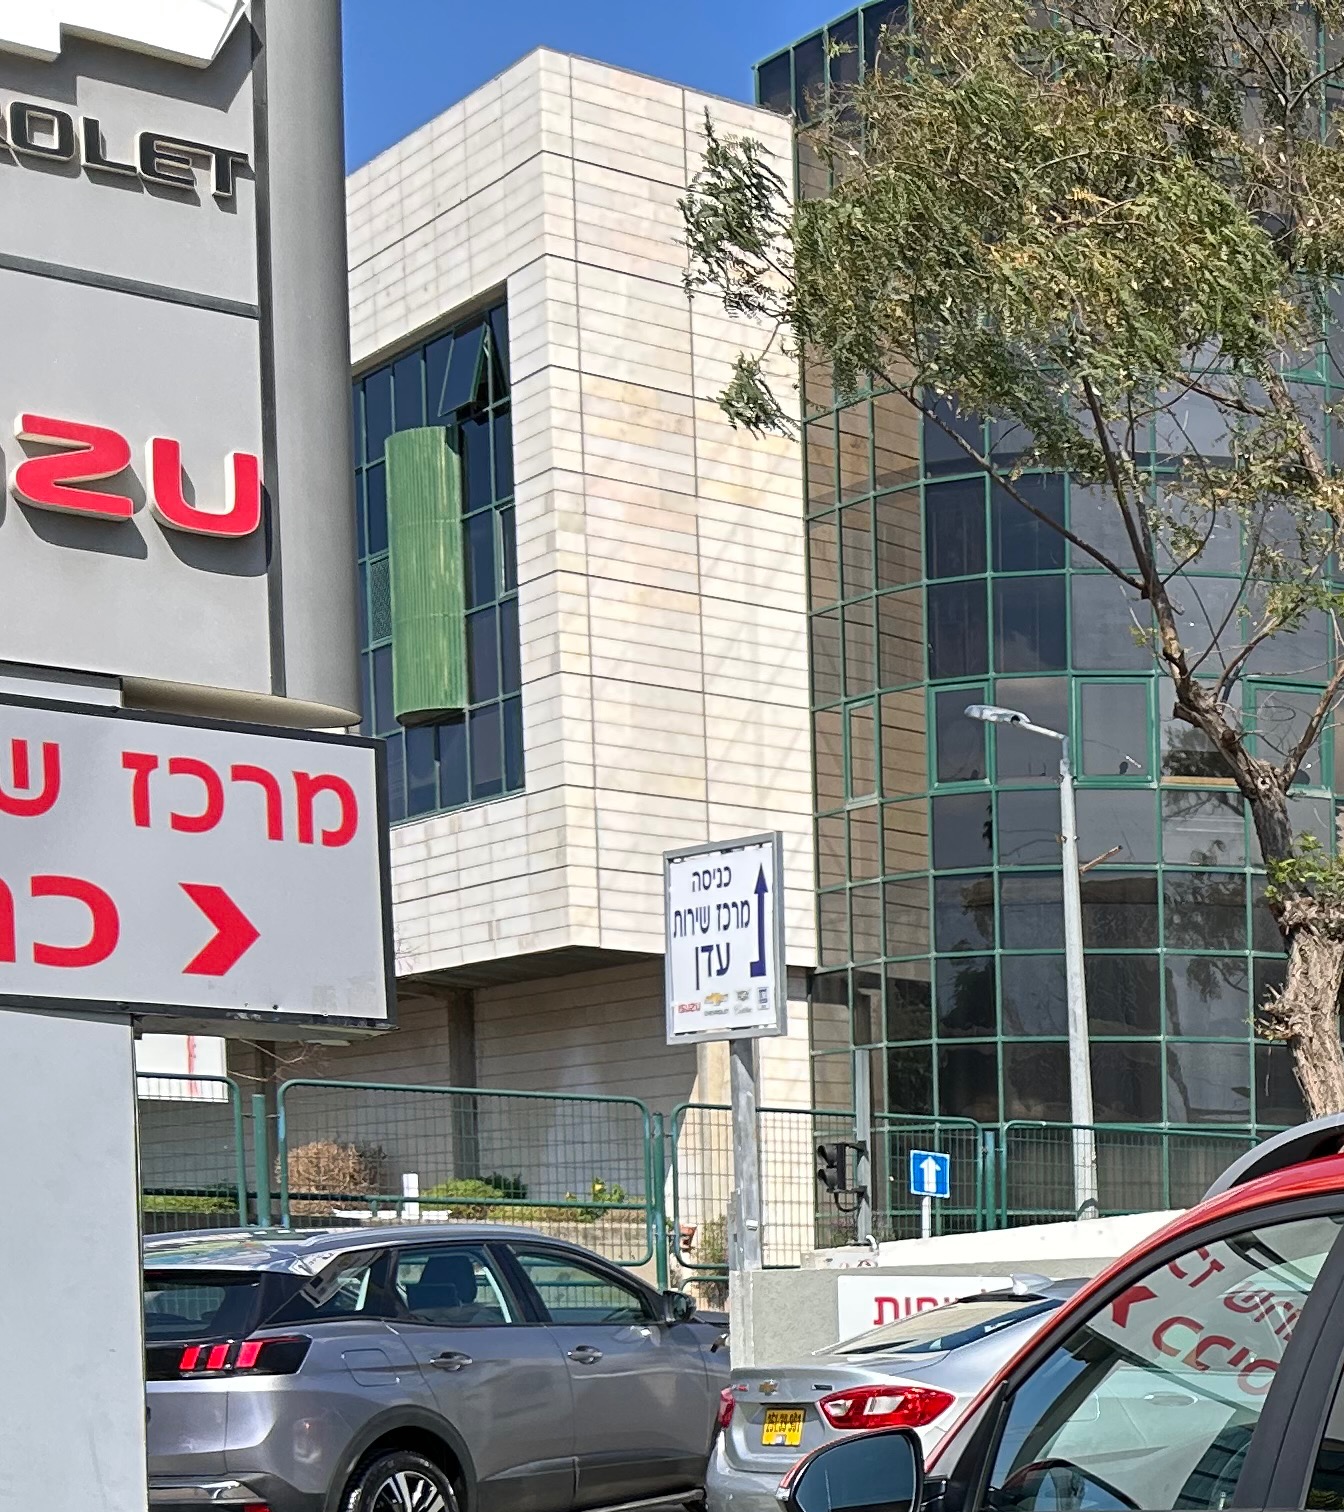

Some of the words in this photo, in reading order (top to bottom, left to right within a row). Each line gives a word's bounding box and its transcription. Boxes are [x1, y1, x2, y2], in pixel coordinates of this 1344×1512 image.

[0, 100, 250, 198] OLET
[121, 750, 360, 848] מרכז
[691, 865, 732, 893] כניסה
[0, 873, 121, 969] כ
[673, 904, 711, 939] שירות
[716, 899, 751, 932] מרכז
[695, 942, 731, 991] עדן
